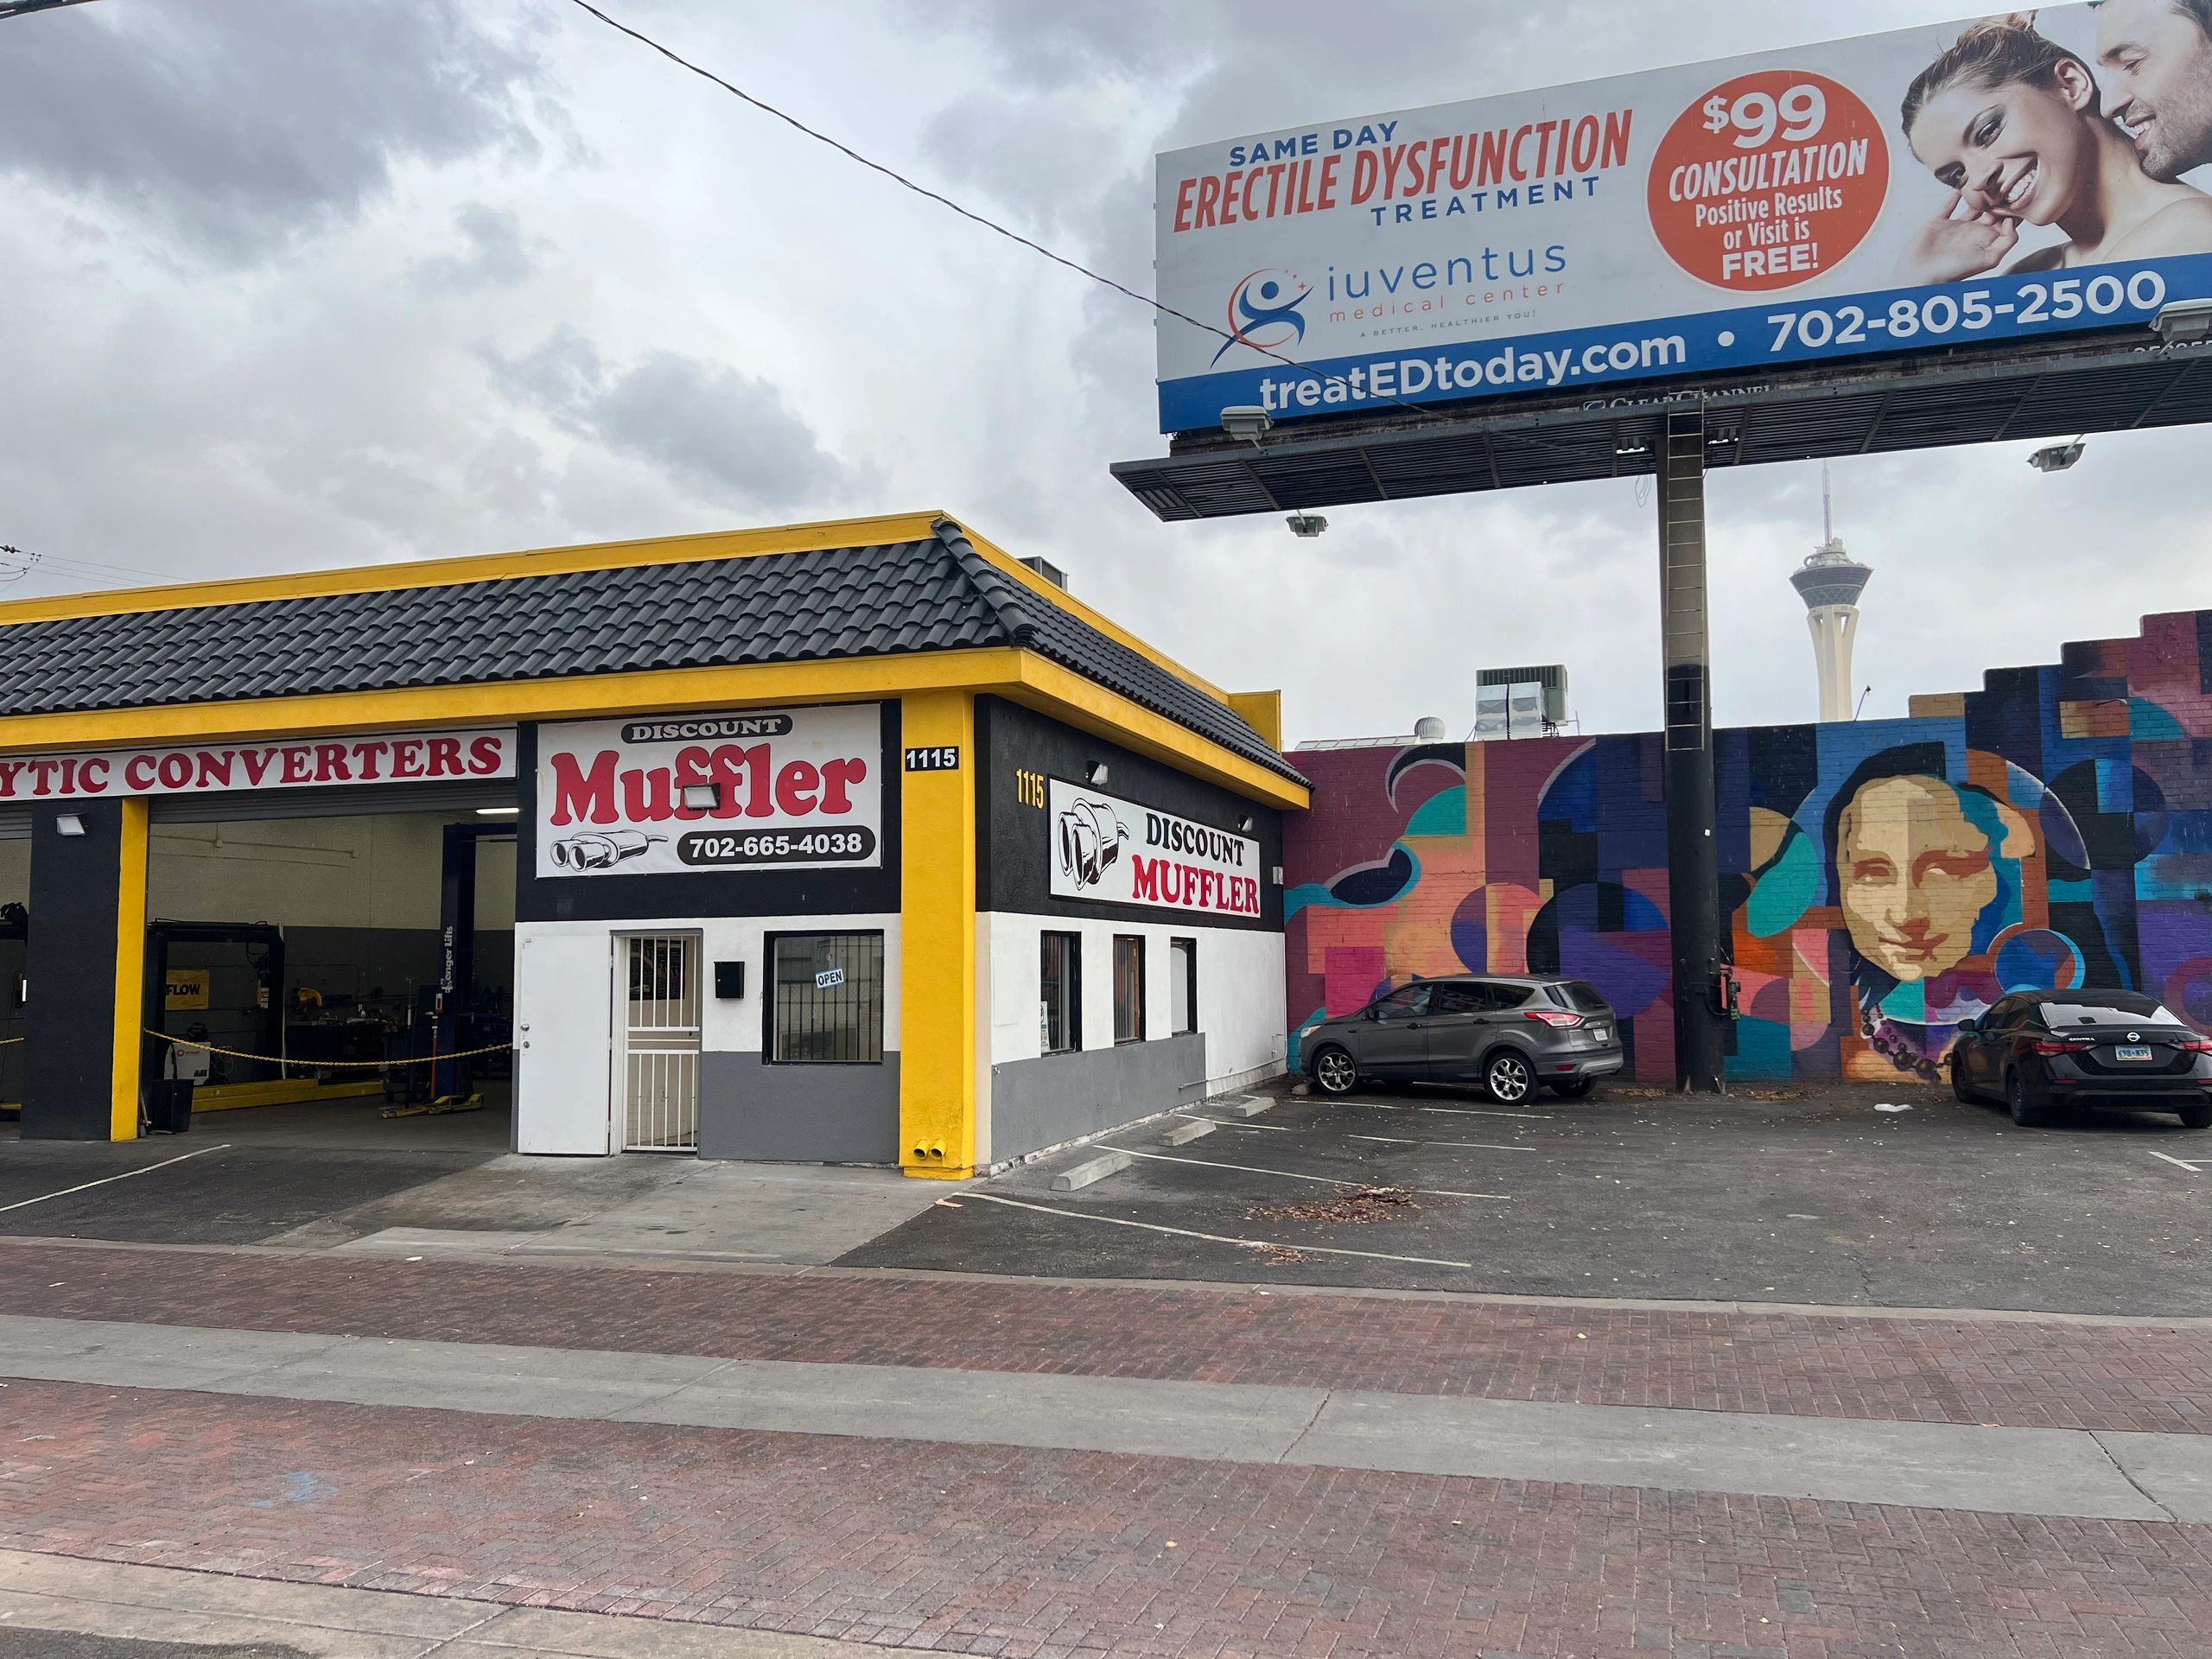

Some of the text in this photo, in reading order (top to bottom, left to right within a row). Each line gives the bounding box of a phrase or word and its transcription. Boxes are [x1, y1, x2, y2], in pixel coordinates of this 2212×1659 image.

[1702, 84, 1826, 149] $99
[1230, 121, 1397, 166] SAME DAY
[1173, 109, 1633, 232] ERECTILE DYSFUNCTION
[1669, 138, 1869, 201] CONSULTATION
[1371, 176, 1600, 226] TREATMENT
[1695, 186, 1842, 227] Positive Results
[1723, 216, 1810, 250] or Visit is
[1328, 245, 1567, 302] iuventus
[1722, 242, 1819, 280] FREE!
[1330, 282, 1564, 323] medical center
[1431, 315, 1499, 329] HEALTHIER
[1506, 310, 1536, 321] YOU!
[1260, 270, 2167, 411] treatEDtoday.com 702-805-2500
[630, 718, 782, 741] DISCOUNT
[0, 736, 503, 797] YTIC CONVERTERS
[906, 748, 956, 769] 1115
[550, 743, 868, 826] Muffler
[1016, 768, 1045, 810] 1115
[689, 832, 862, 859] 702-665-4038
[1145, 812, 1244, 867] DISCOUNT
[1131, 854, 1260, 914] MUFFLER
[817, 969, 843, 987] OPEN
